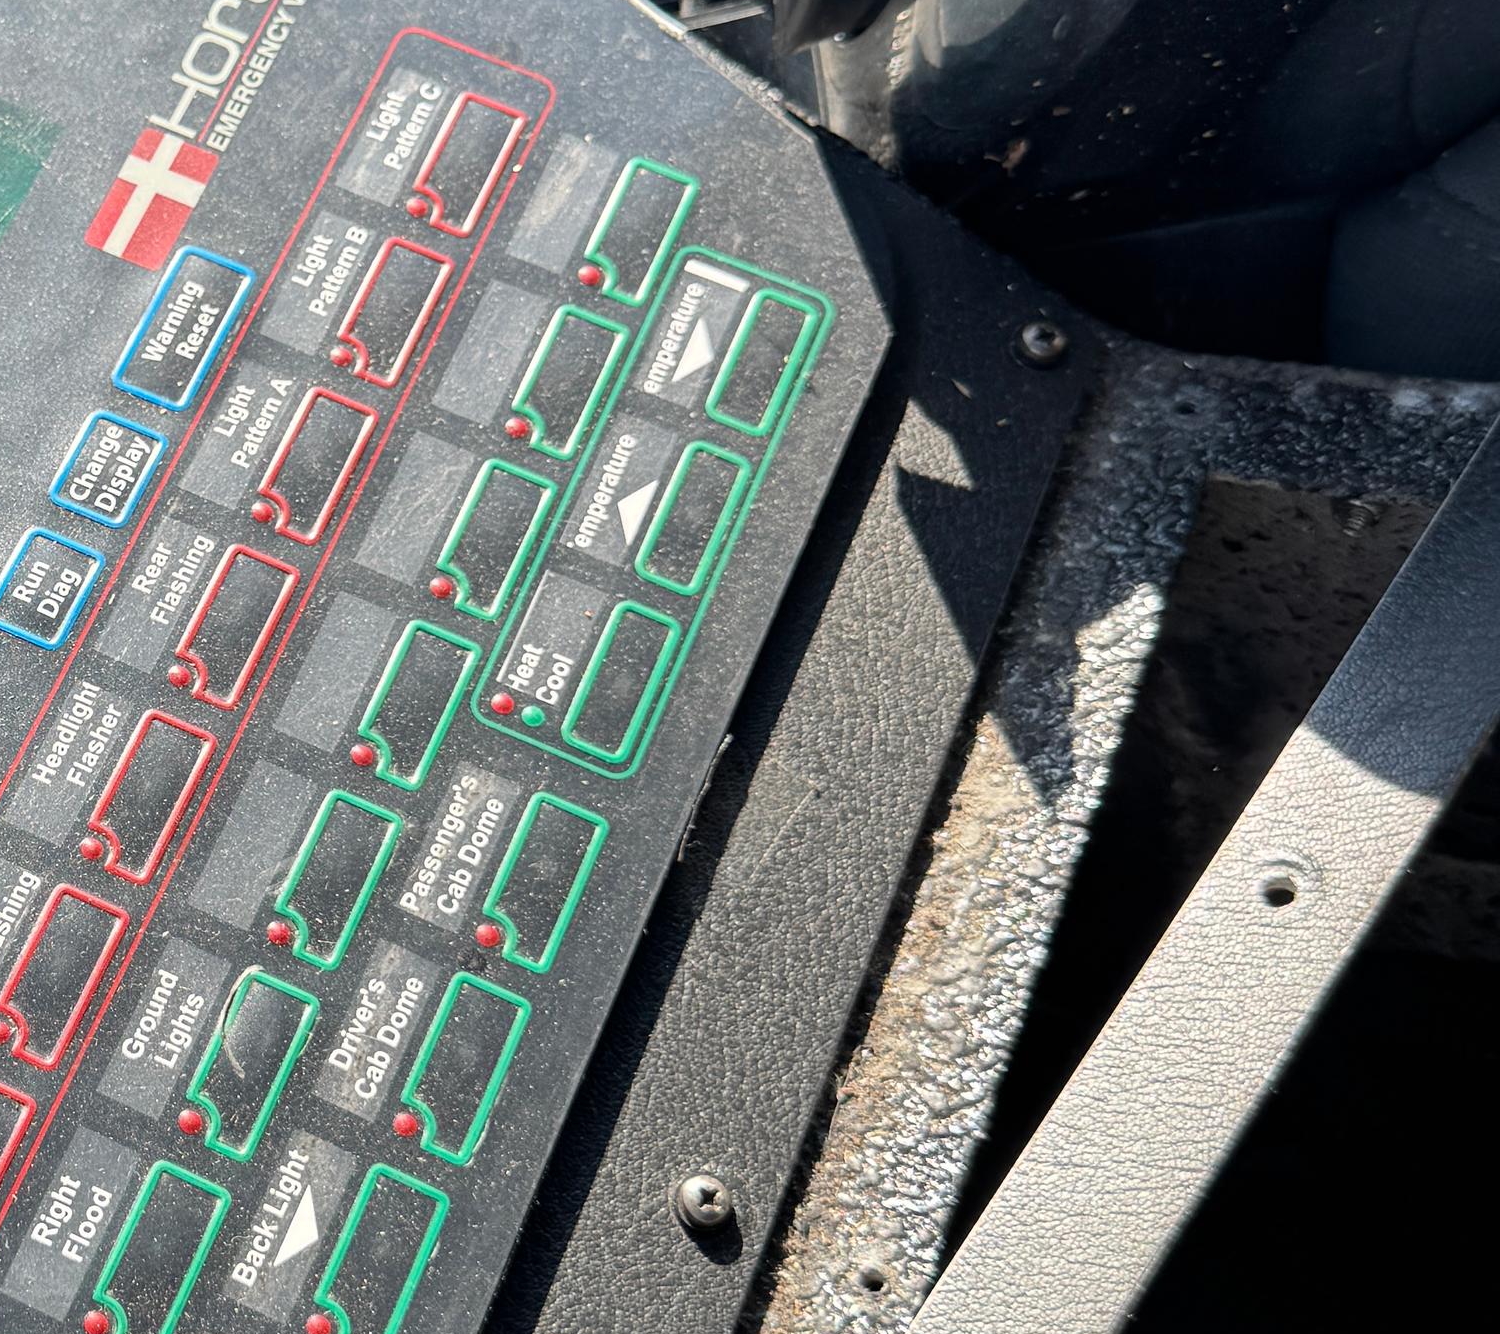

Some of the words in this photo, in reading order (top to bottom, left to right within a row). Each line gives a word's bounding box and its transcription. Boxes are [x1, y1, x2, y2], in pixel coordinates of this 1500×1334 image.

[206, 7, 297, 153] EMERGENCY
[365, 88, 406, 143] Light
[384, 97, 429, 171] Pattern
[418, 81, 444, 102] C
[291, 234, 334, 288] Light
[308, 245, 359, 318] Pattern
[345, 225, 369, 246] B
[140, 280, 206, 364] Warning
[174, 303, 220, 360] Reset
[643, 282, 705, 394] emperature
[213, 384, 256, 438] Light
[230, 397, 283, 468] Pattern
[271, 378, 293, 398] A
[68, 424, 124, 502] Change
[93, 436, 151, 513] Display
[566, 433, 636, 548] emperature
[12, 559, 48, 604] Run
[37, 567, 82, 619] Diag
[131, 541, 172, 594] Rear
[150, 533, 215, 625] Flashing
[506, 644, 543, 691] Heat
[536, 654, 574, 706] Cool
[66, 704, 121, 788] Flasher
[400, 773, 478, 913] Passenger's
[437, 866, 472, 914] Cab
[458, 798, 504, 864] Dome
[121, 969, 178, 1060] Ground
[155, 993, 204, 1069] Lights
[328, 976, 386, 1069] Driver's
[354, 1050, 389, 1100] Cab
[376, 976, 424, 1047] Dome
[32, 1174, 81, 1248] Right
[62, 1188, 113, 1263] Flood
[233, 1214, 272, 1287] Back
[263, 1149, 309, 1220] Light
